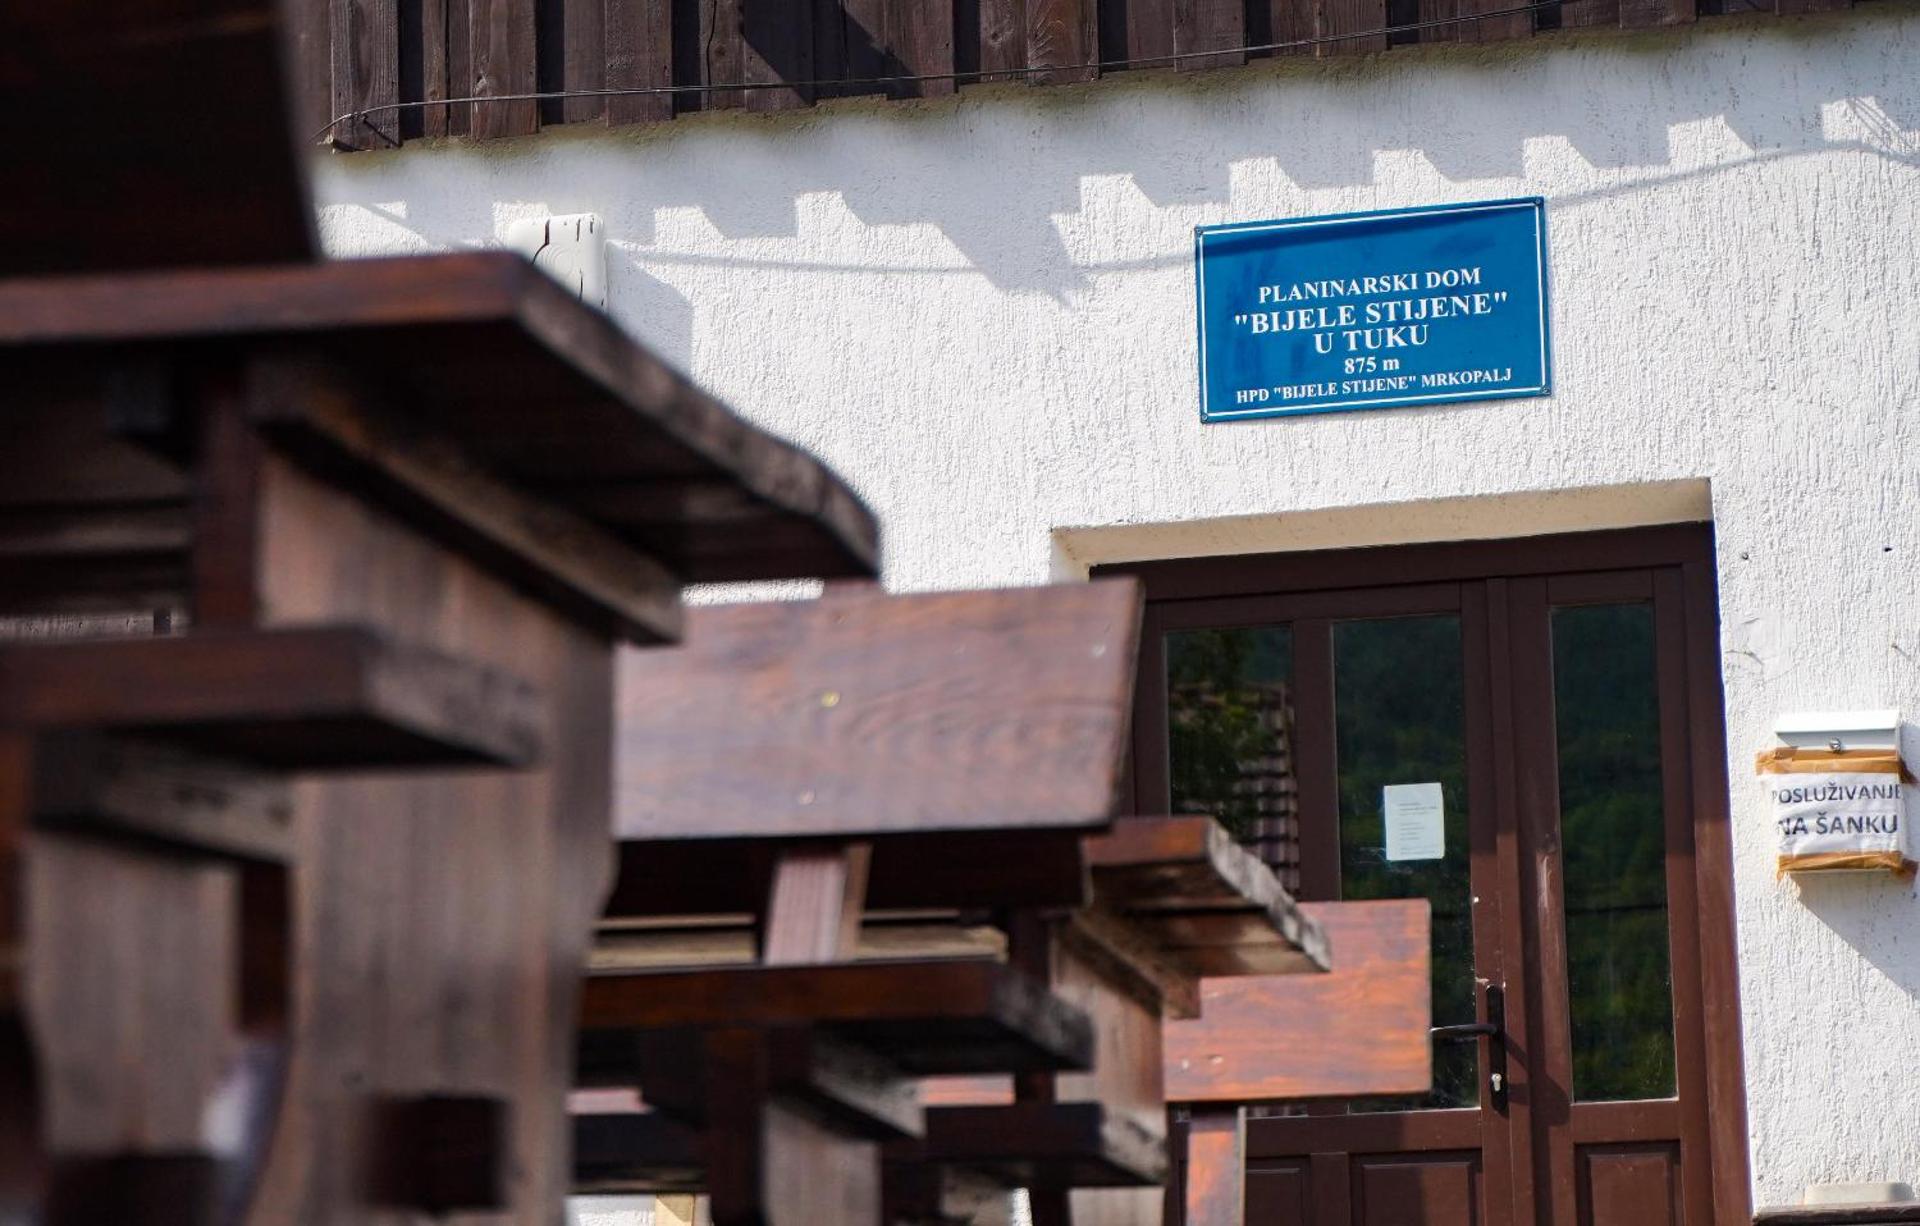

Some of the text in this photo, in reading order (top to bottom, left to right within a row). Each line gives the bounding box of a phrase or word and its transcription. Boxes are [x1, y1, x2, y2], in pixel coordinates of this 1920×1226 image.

[1258, 267, 1481, 304] PLANINARSKI DOM
[1234, 291, 1508, 334] "BIJELE STIJENE"
[1314, 324, 1429, 354] U TUKU
[1344, 357, 1400, 375] 875 m
[1236, 368, 1512, 404] HPD "BIJELE STIJENE" MRKOPALJ
[1816, 811, 1898, 835] ŠANKU
